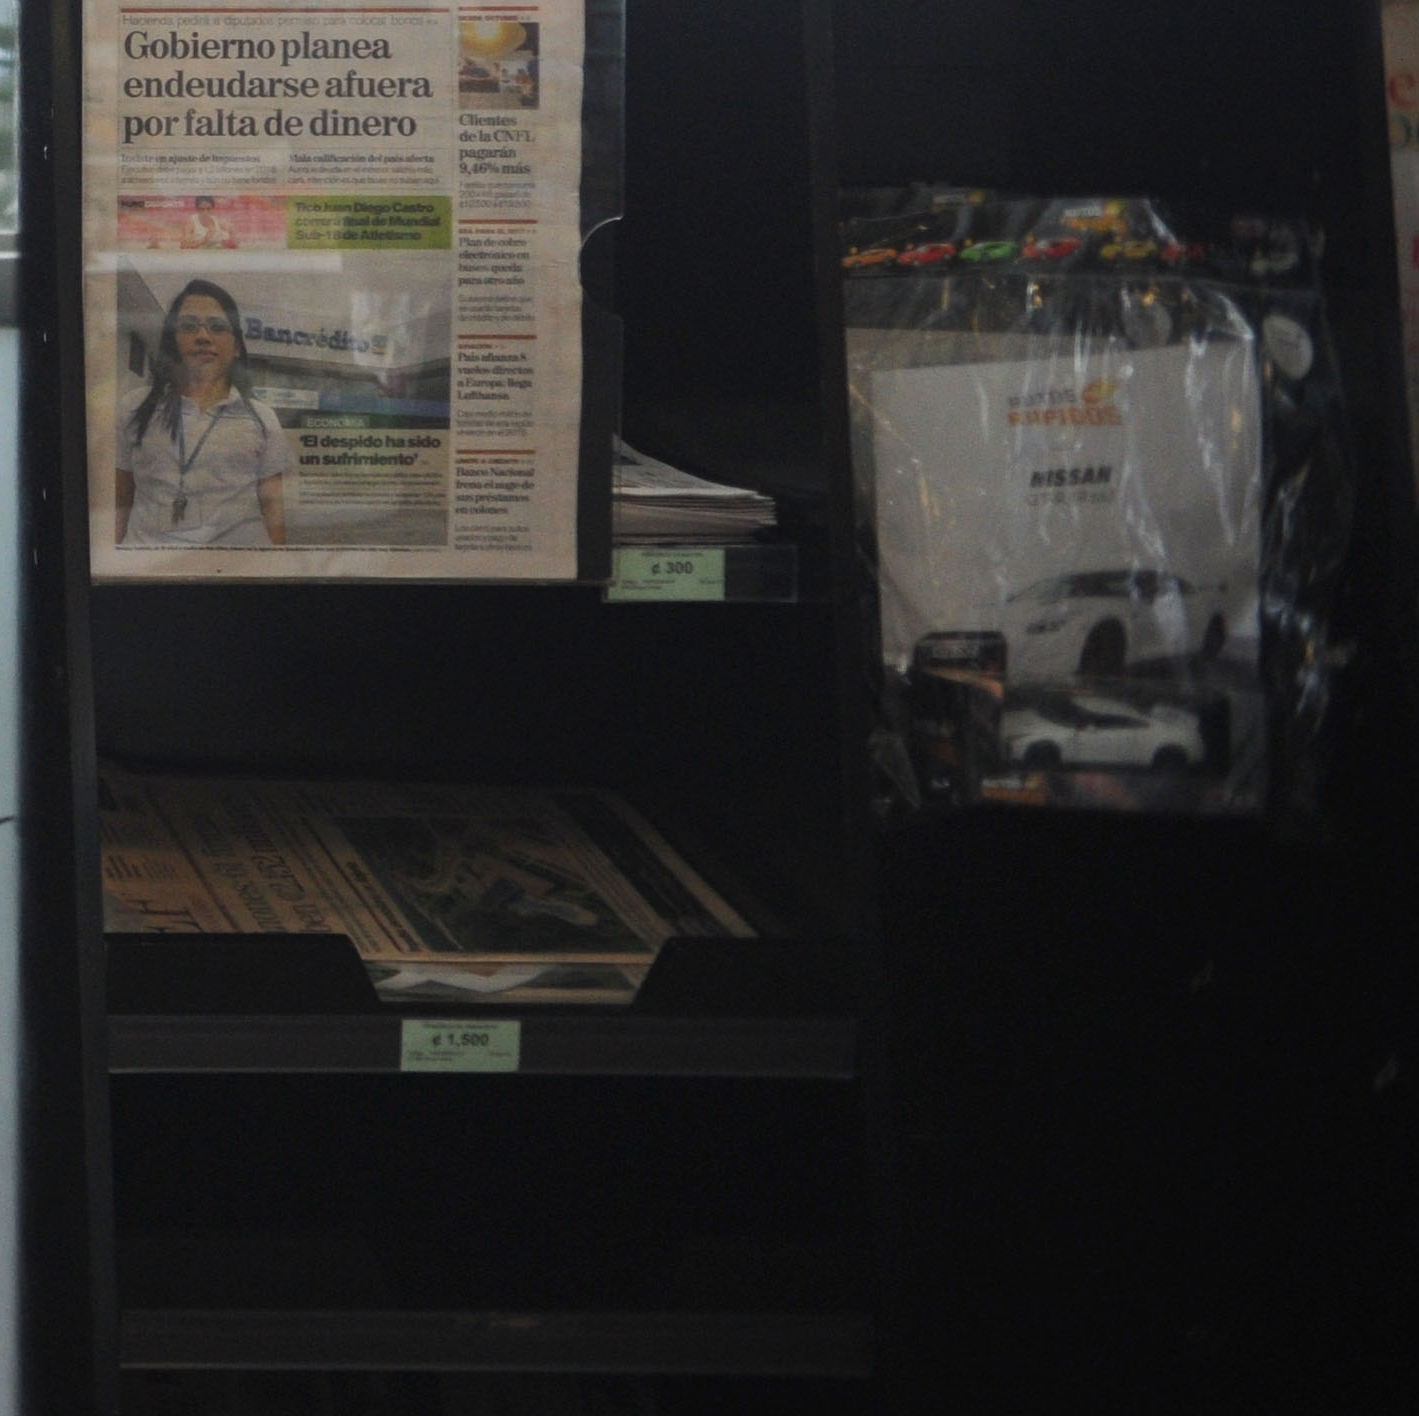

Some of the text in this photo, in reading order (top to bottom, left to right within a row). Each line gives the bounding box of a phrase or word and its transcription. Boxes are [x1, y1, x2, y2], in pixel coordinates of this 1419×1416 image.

[124, 31, 392, 66] Gobierno planea
[123, 70, 434, 98] endeudarse afuera
[122, 109, 417, 143] por falta de dinero
[459, 114, 518, 126] Clientes
[459, 130, 477, 142] de
[320, 435, 382, 451] despido
[385, 435, 406, 448] ha
[408, 435, 442, 448] sido
[299, 455, 320, 465] un
[666, 561, 694, 574] 300
